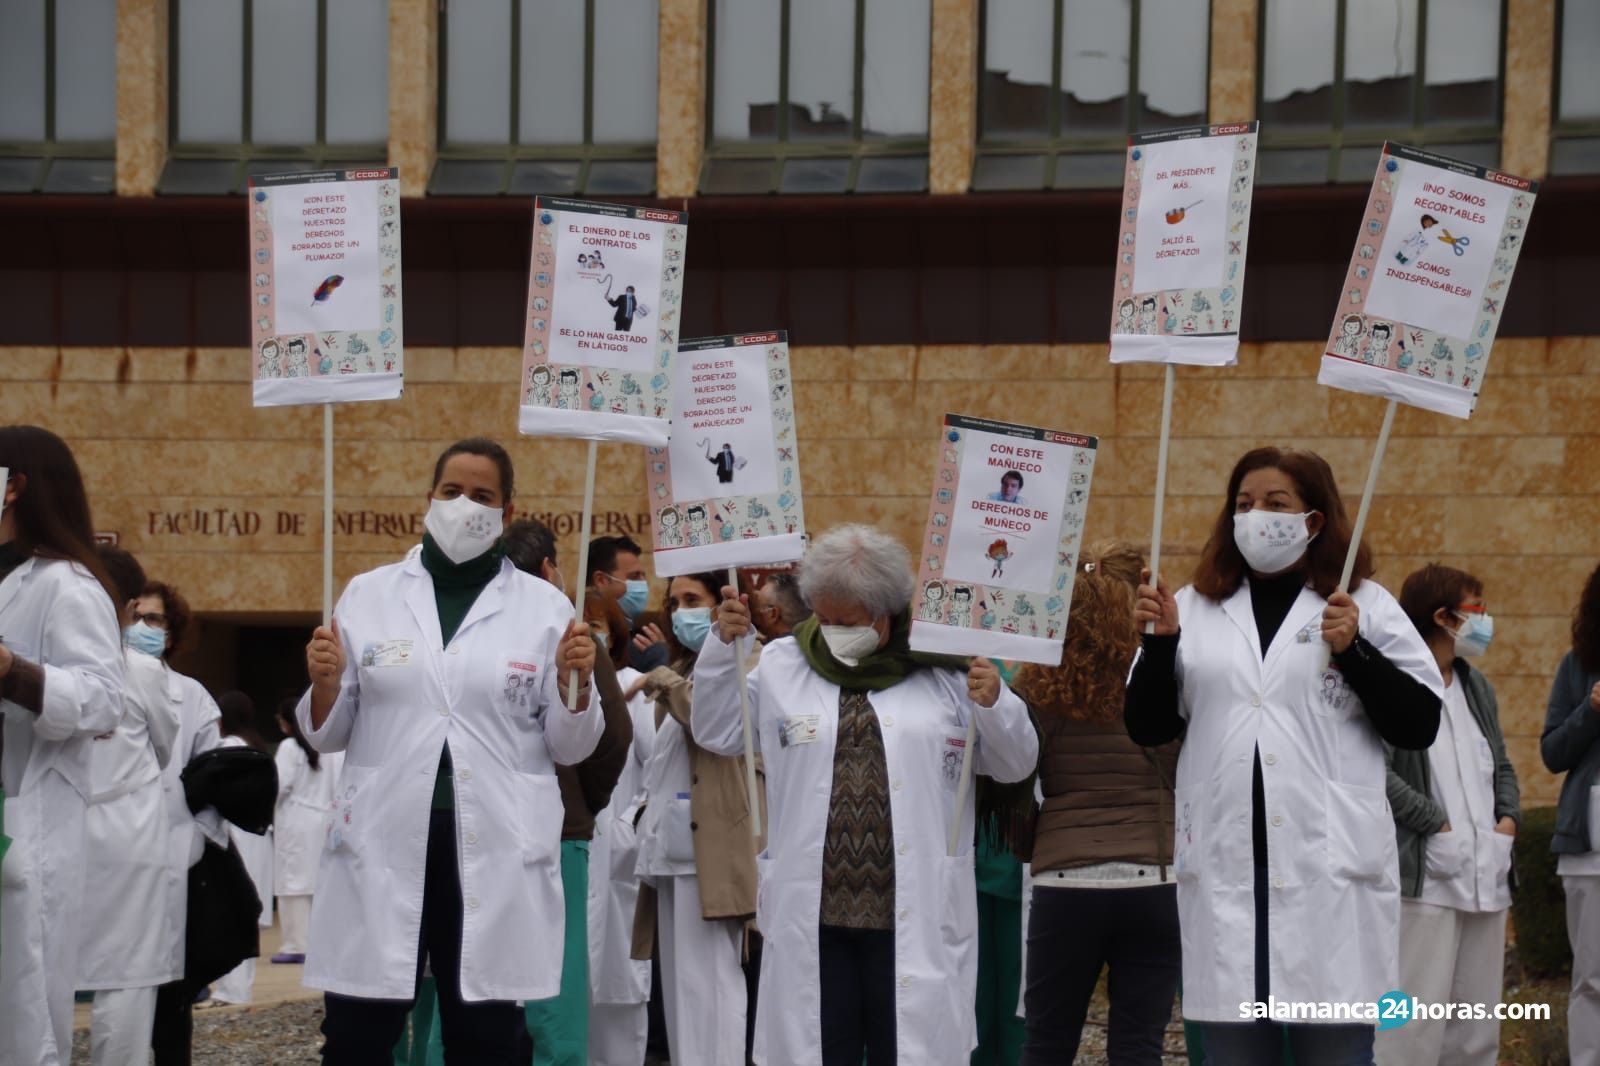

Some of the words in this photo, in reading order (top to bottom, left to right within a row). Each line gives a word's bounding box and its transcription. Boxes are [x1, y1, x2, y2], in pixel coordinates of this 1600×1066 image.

[1219, 126, 1241, 135] CCOO
[356, 171, 379, 179] CCOO
[1156, 172, 1169, 181] DEL
[1170, 166, 1216, 177] PRESIDENTE
[1495, 175, 1519, 187] CCOO
[325, 195, 345, 203] ESTE
[1447, 190, 1487, 208] SOMOS
[302, 206, 347, 216] DECRETAZO
[646, 212, 669, 221] CCOO
[1413, 197, 1487, 225] RECORTABLES
[303, 218, 346, 227] NUESTROS
[305, 230, 345, 239] DERECHOS
[568, 224, 581, 234] EL
[582, 225, 617, 238] DINERO
[619, 230, 632, 239] DE
[633, 232, 651, 241] LOS
[291, 242, 332, 251] BORRADOS
[335, 241, 345, 249] DE
[347, 240, 360, 248] UN
[582, 236, 638, 250] CONTRATOS
[1161, 234, 1184, 246] SALIÓ
[1186, 235, 1195, 244] EL
[1416, 261, 1452, 277] SOMOS
[1385, 267, 1473, 298] INDISPENSABLES!!
[559, 328, 571, 337] SE
[572, 330, 586, 338] LO
[587, 331, 606, 340] HAN
[606, 333, 648, 345] GASTADO
[745, 335, 767, 344] CCOO
[577, 341, 591, 350] EN
[592, 341, 629, 353] LÁTIGOS
[714, 360, 735, 369] ESTE
[691, 372, 737, 383] DECRETAZO
[694, 384, 737, 394] NUESTROS
[696, 396, 737, 406] DERECHOS
[683, 408, 725, 418] BORRADOS
[727, 406, 738, 414] DE
[740, 405, 753, 413] UN
[1055, 434, 1078, 443] CCOO
[990, 443, 1014, 454] CON
[1016, 447, 1044, 460] ESTE
[987, 456, 1043, 474] MAÑUECO
[971, 500, 1031, 518] DERECHOS
[1033, 511, 1049, 521] DE
[147, 508, 262, 536] FACULTAD
[276, 511, 307, 537] DE
[984, 515, 1032, 532] MUÑECO
